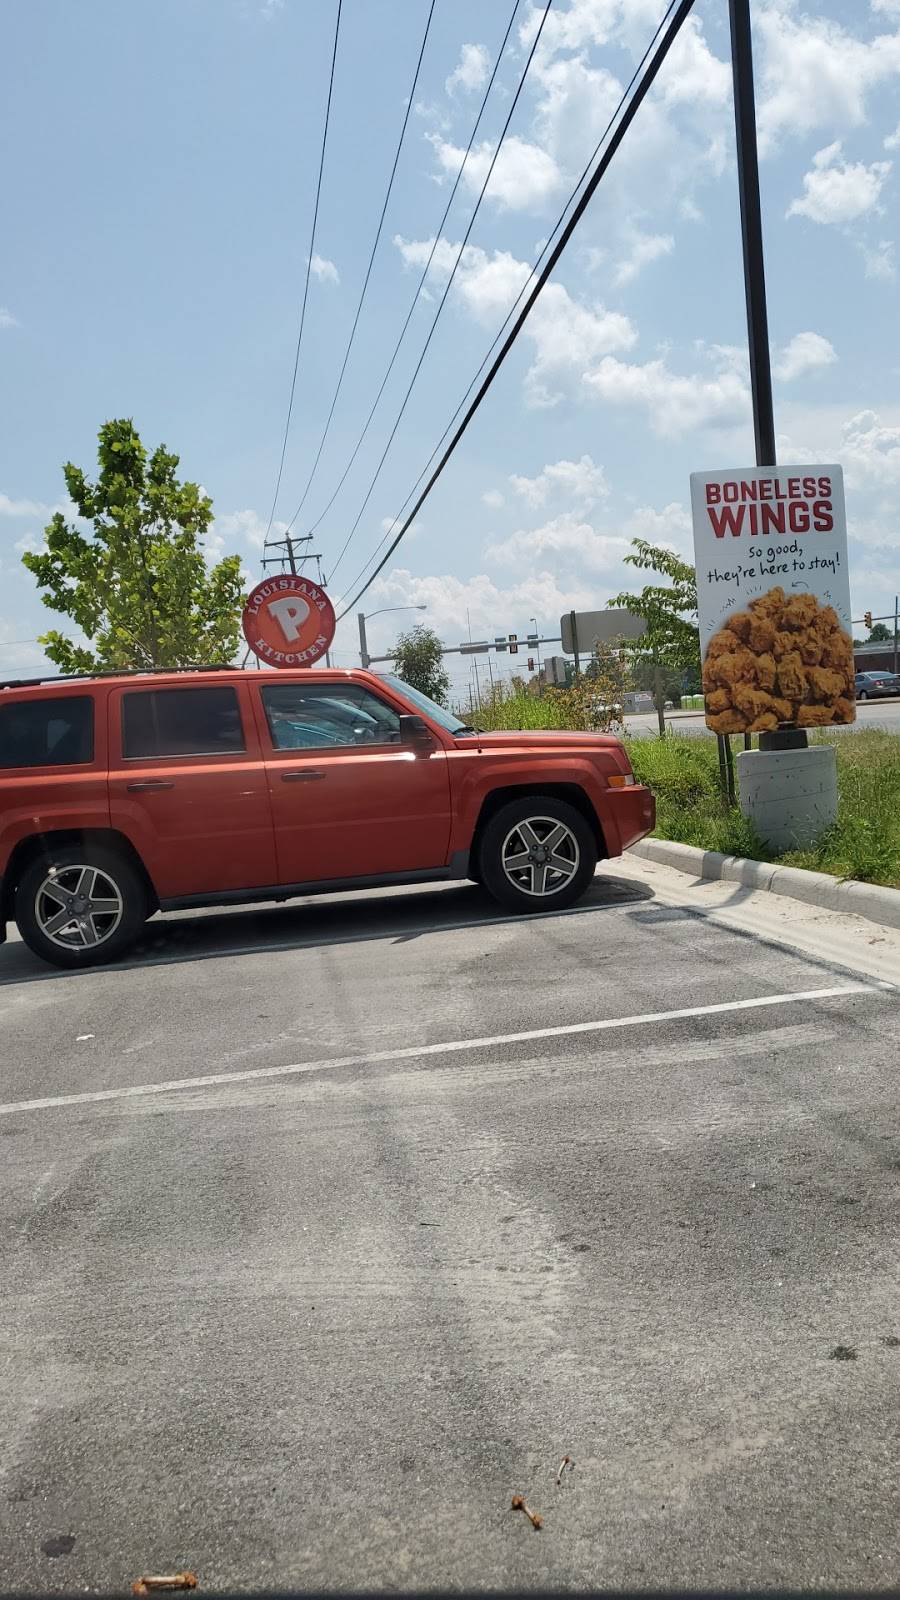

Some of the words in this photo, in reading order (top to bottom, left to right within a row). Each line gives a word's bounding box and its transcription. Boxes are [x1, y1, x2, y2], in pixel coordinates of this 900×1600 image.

[705, 477, 832, 504] BONELESS
[707, 500, 834, 539] WINGS
[707, 566, 756, 586] they're
[759, 563, 790, 576] here
[793, 560, 805, 570] to
[808, 551, 841, 575] stay!
[767, 540, 803, 563] good,
[248, 580, 326, 615] LOUISIANA
[267, 596, 311, 642] P
[256, 634, 327, 663] KITCHEN
